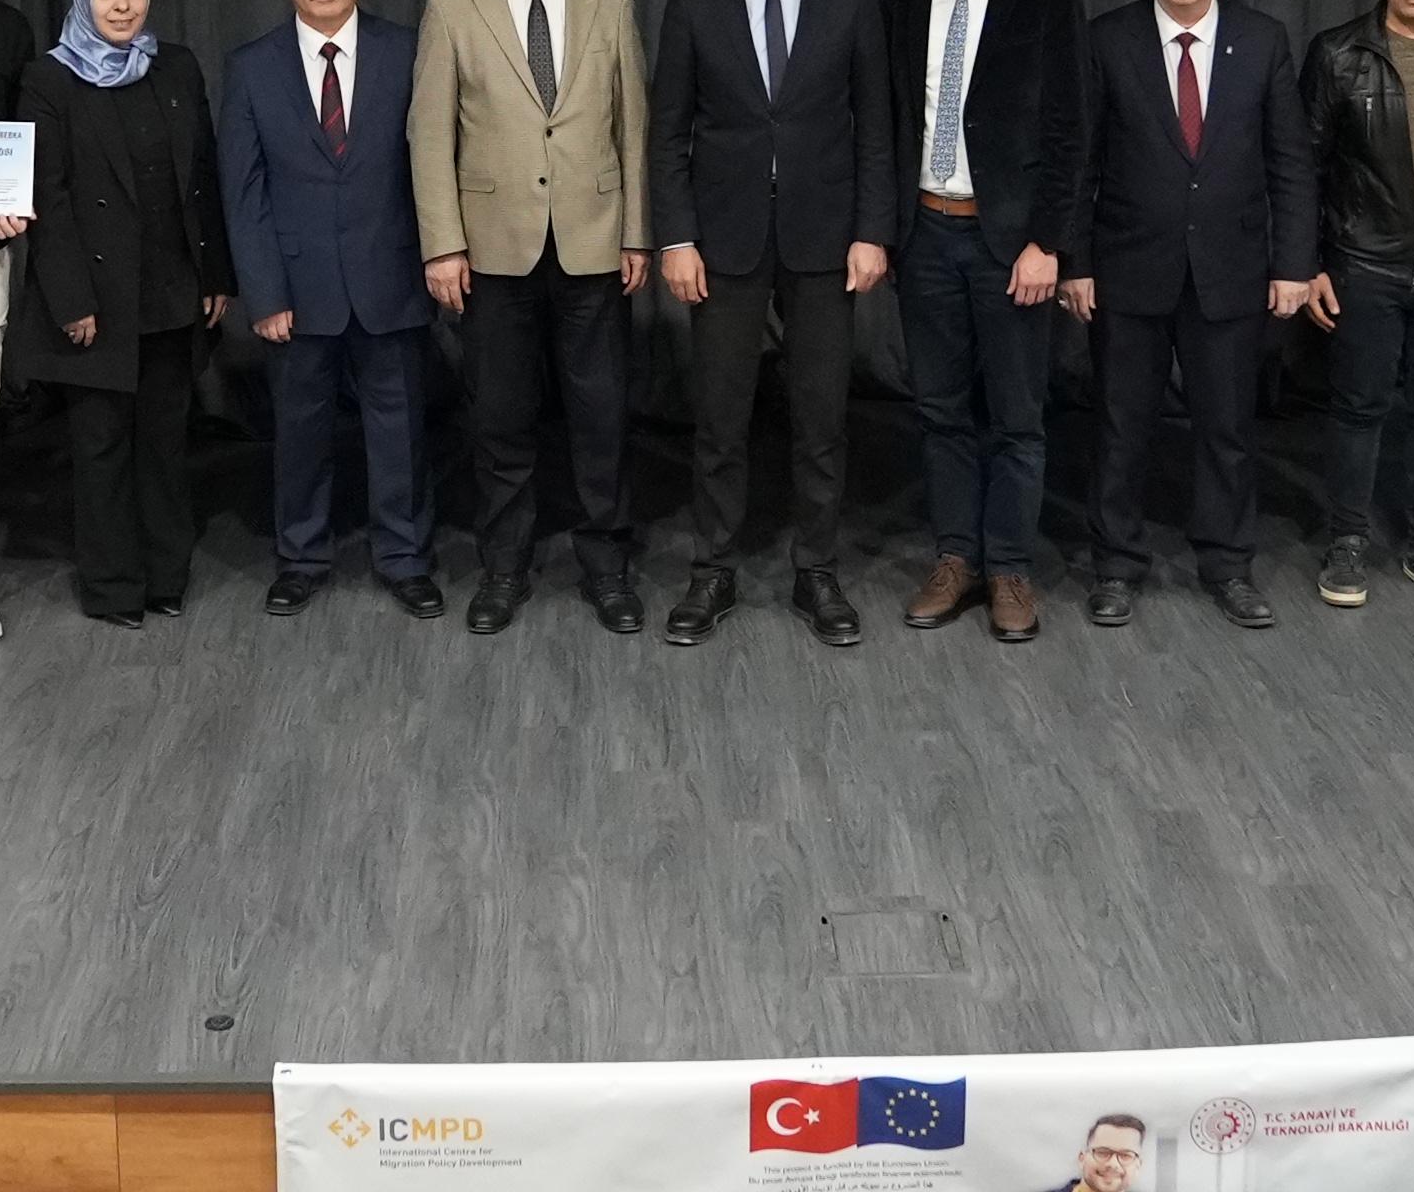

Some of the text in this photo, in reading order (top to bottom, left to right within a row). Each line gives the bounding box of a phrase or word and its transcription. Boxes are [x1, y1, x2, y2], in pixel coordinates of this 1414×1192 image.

[1265, 1107, 1357, 1123] T.C. SANAYİ VE
[379, 1118, 483, 1142] ICMPD
[1265, 1119, 1410, 1136] TEKNOLOJİ BAKANLIĞI
[379, 1147, 492, 1156] International Centre for
[379, 1158, 523, 1169] Migration Policy Development
